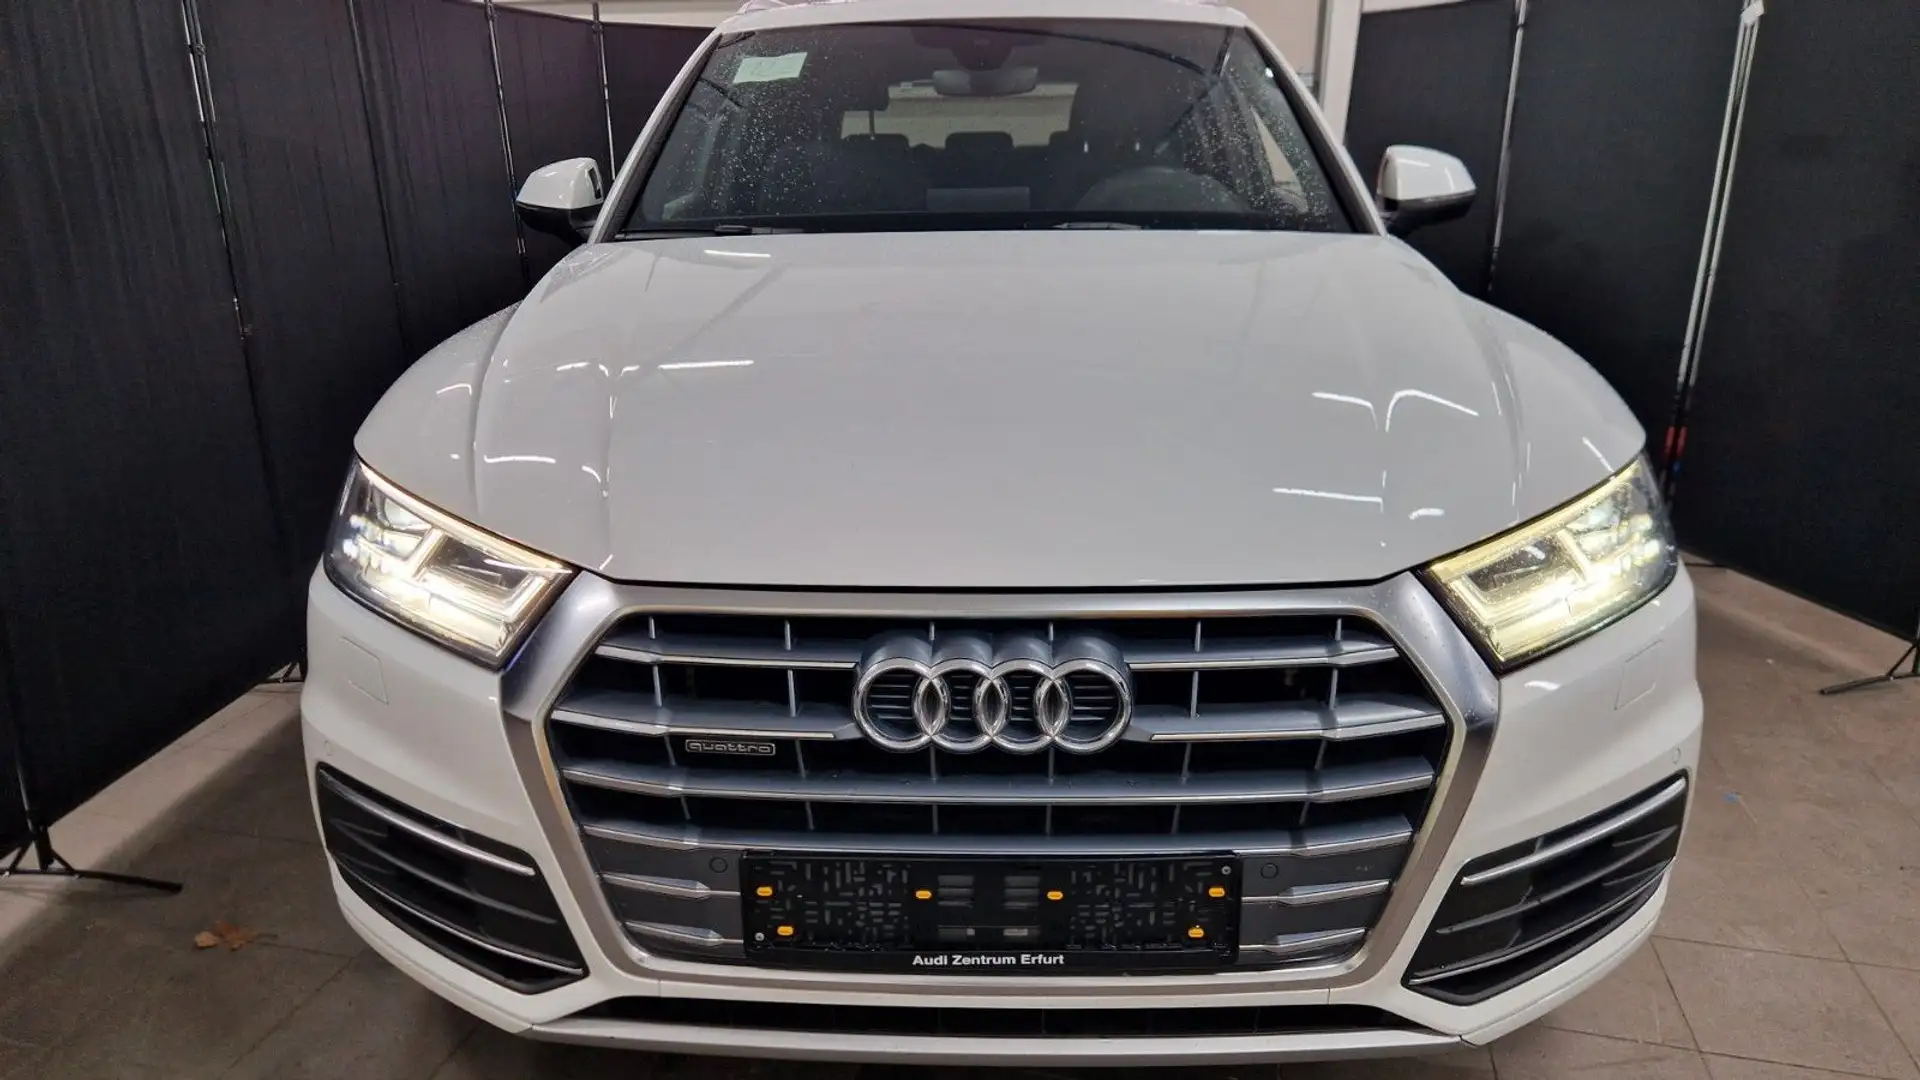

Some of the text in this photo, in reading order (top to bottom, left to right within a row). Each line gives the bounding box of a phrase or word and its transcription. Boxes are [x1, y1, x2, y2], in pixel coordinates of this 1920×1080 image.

[688, 742, 772, 754] quattro
[912, 954, 1064, 966] Audi Zentrum Erfurt
